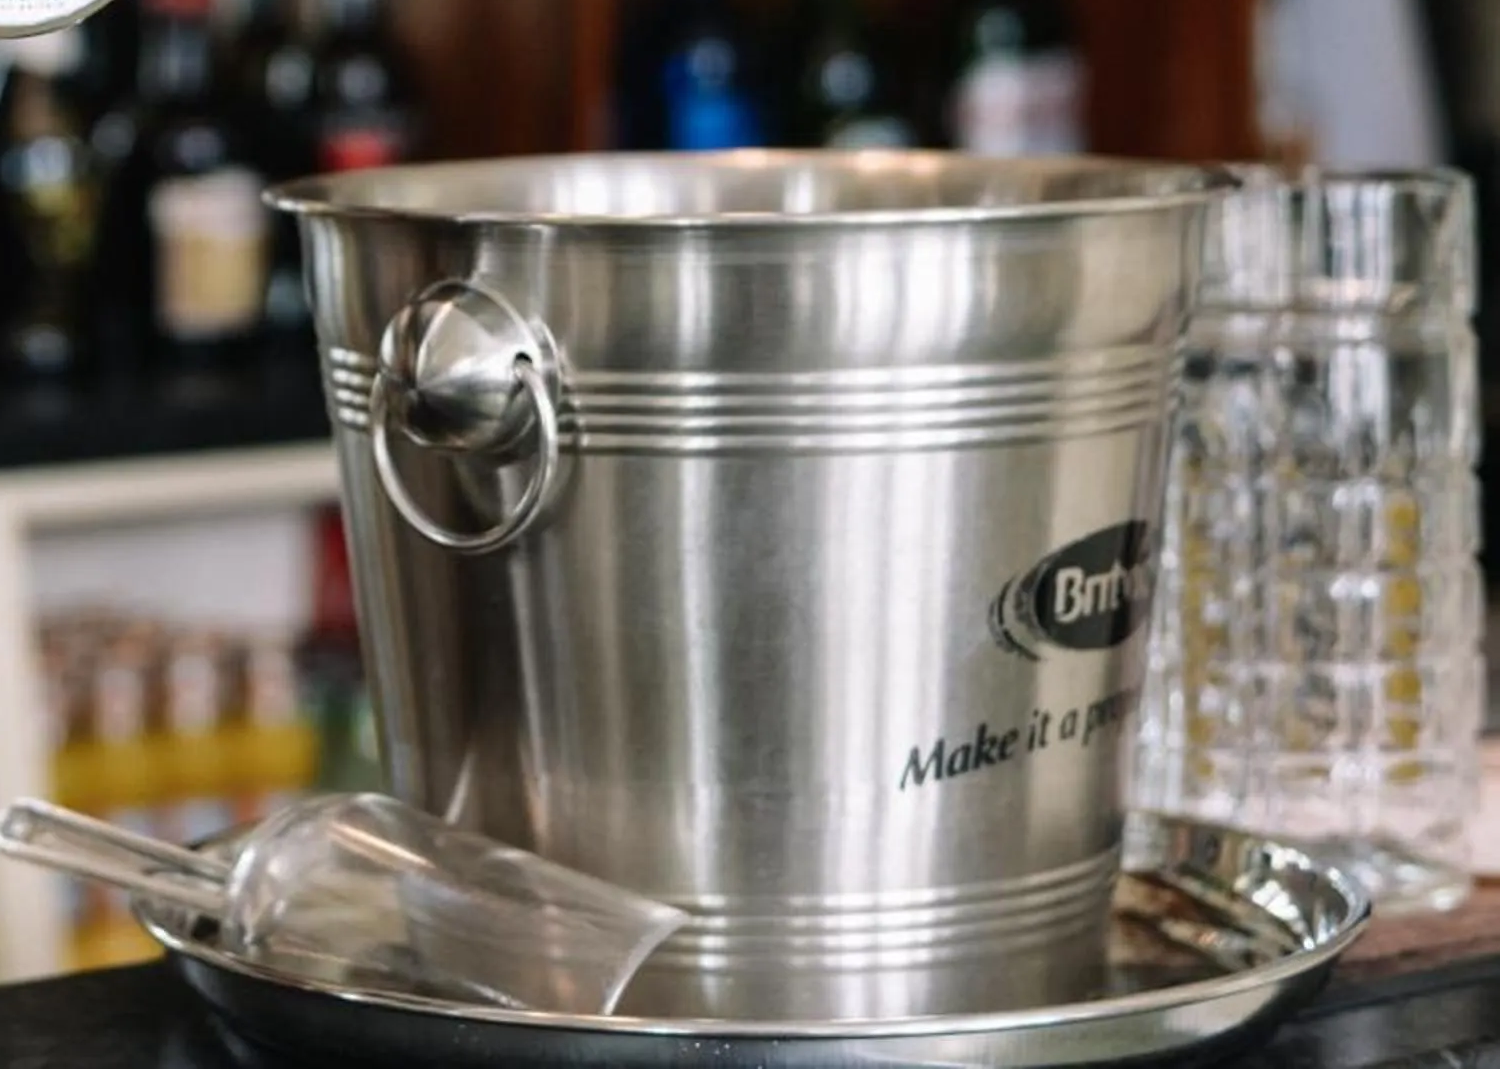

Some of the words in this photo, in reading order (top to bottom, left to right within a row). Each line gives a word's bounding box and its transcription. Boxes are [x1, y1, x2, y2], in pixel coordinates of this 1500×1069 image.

[900, 723, 1020, 792] Make
[1027, 710, 1052, 752] it
[1058, 708, 1079, 741] a
